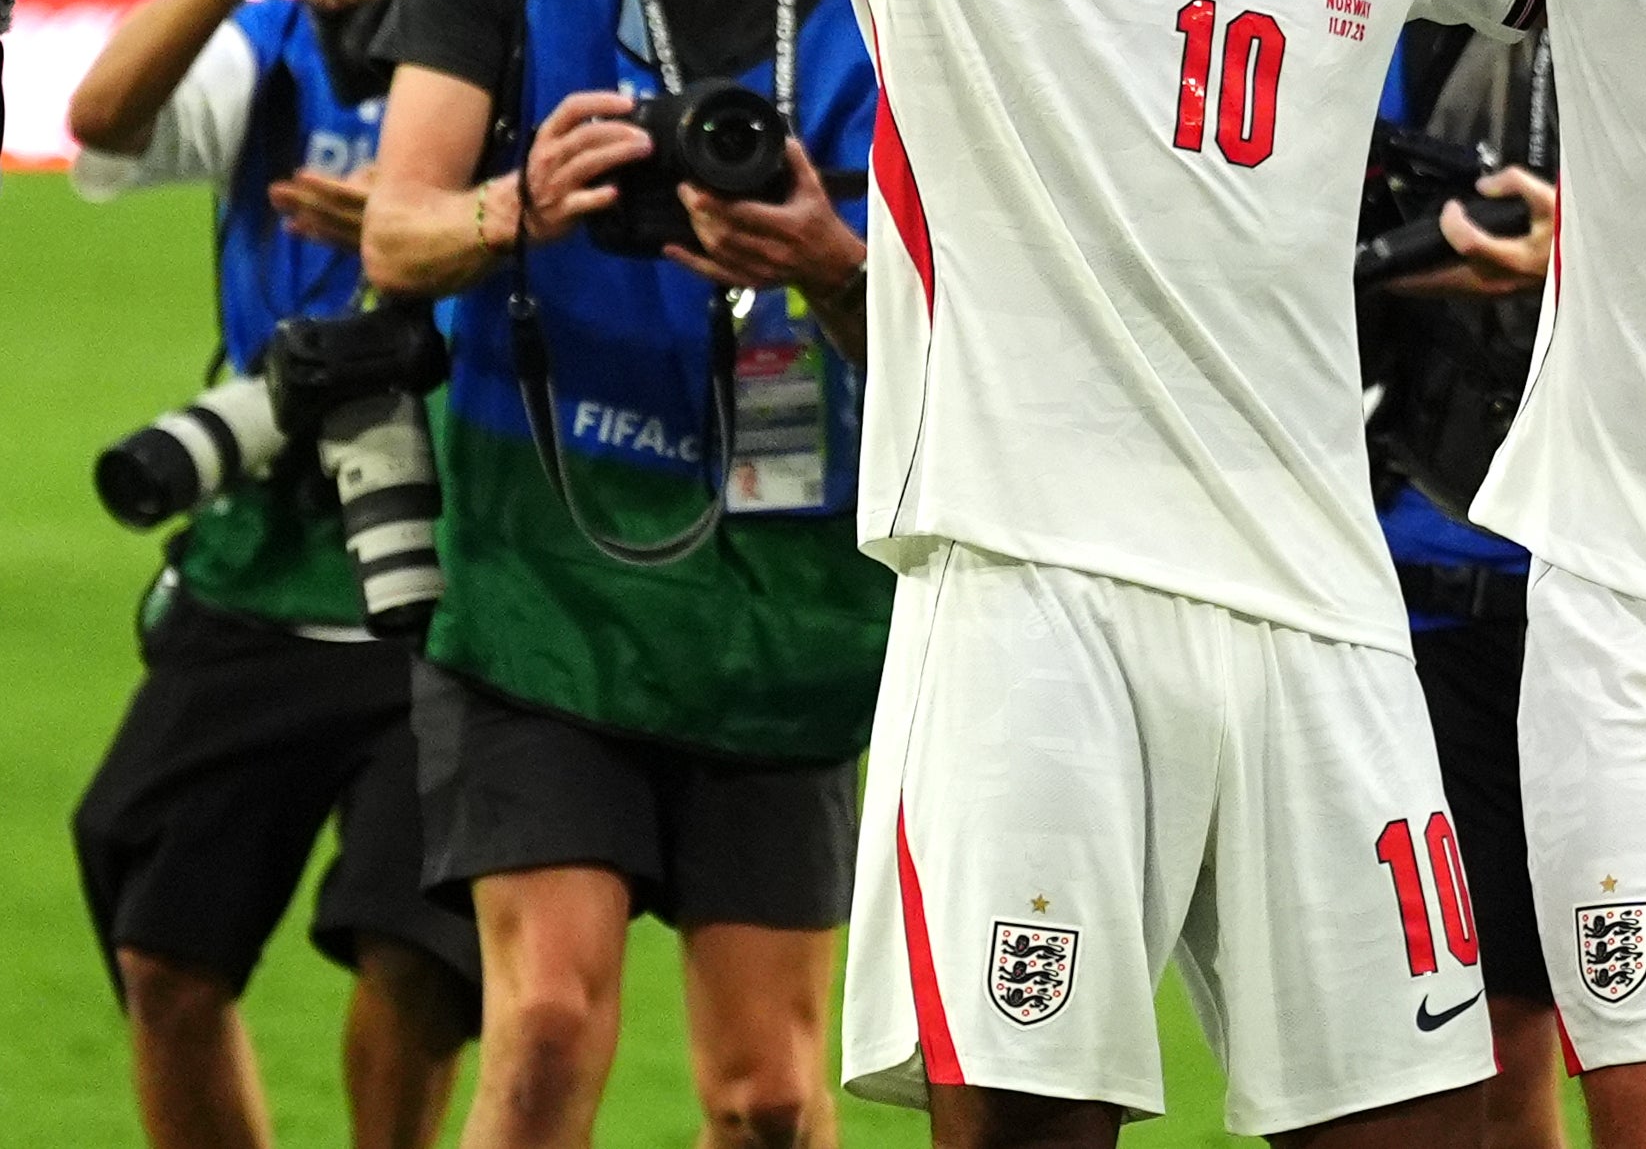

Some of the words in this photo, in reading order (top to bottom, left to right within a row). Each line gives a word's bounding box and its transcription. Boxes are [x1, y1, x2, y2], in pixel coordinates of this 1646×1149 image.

[1328, 16, 1365, 42] 11.07.26
[572, 401, 700, 463] FIFA.c
[1375, 811, 1479, 978] 10
